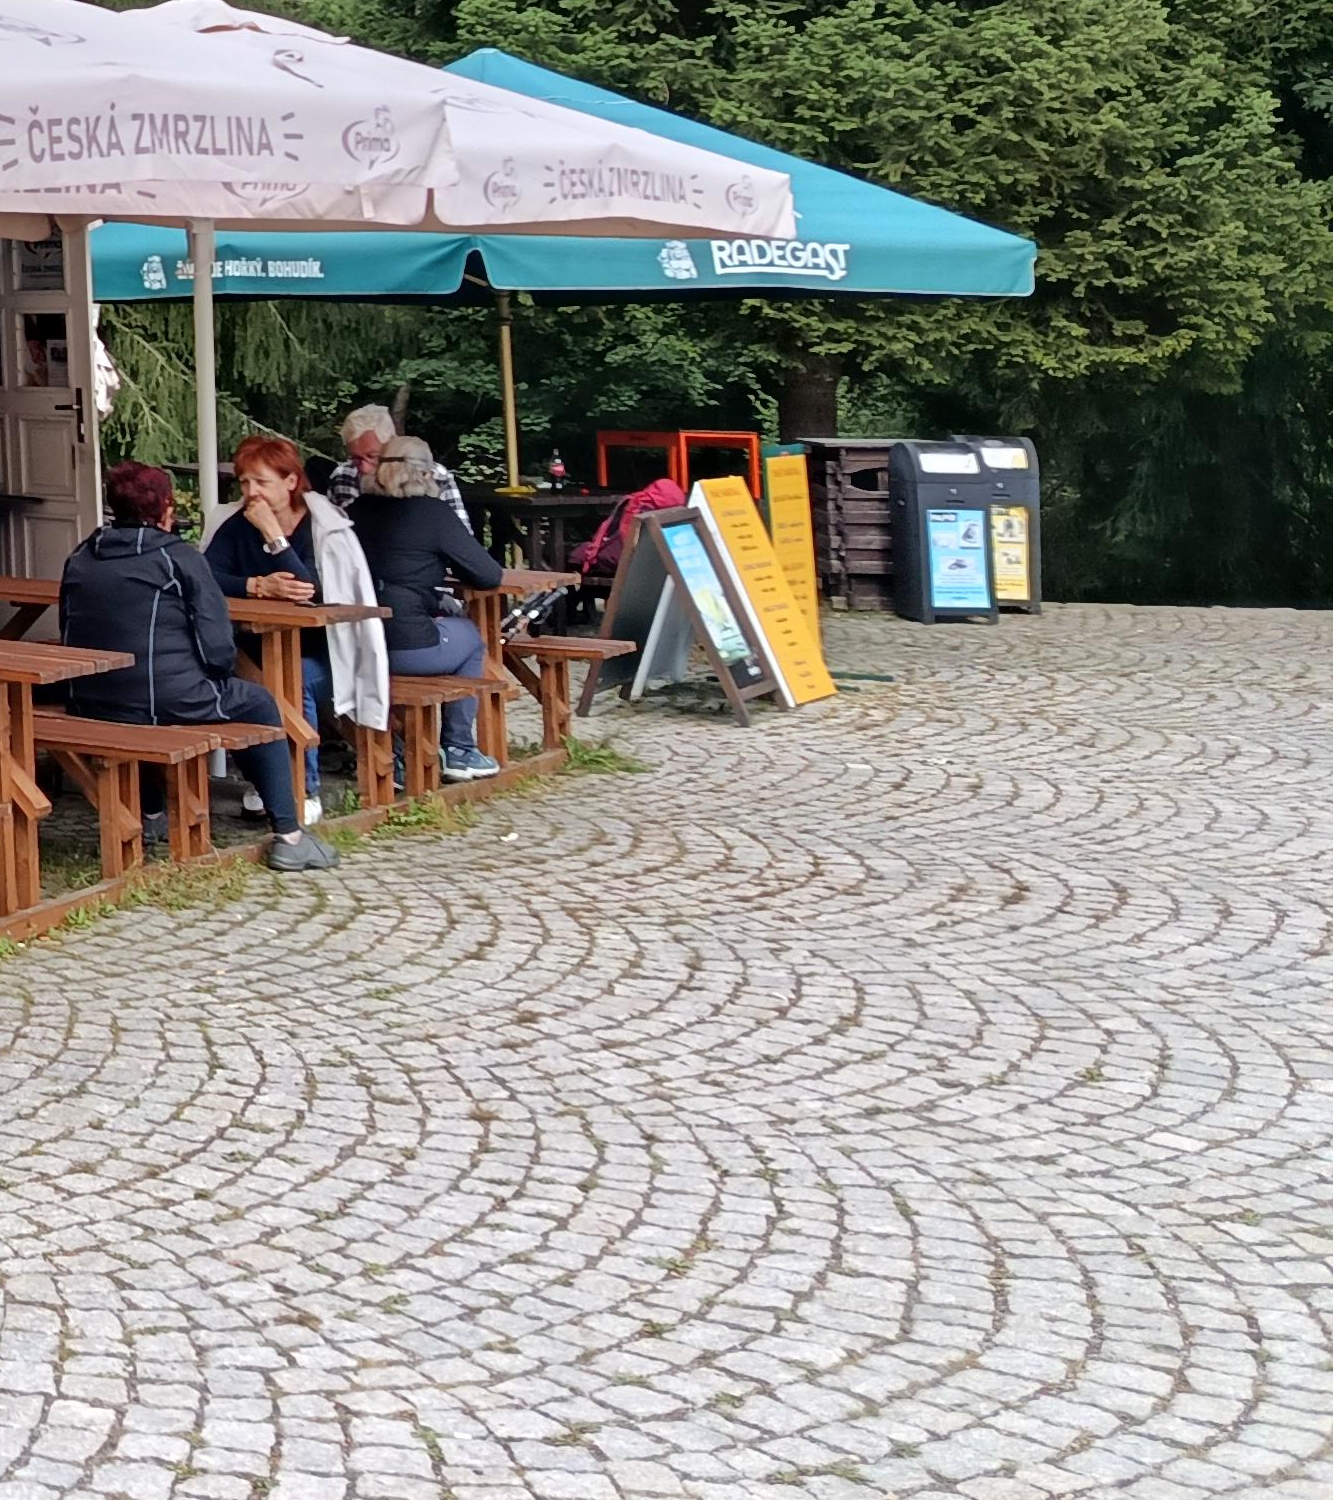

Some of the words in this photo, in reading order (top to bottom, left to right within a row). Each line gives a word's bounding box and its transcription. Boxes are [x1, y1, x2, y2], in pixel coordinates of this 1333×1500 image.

[27, 102, 126, 164] ČESKÁ
[131, 112, 275, 157] ZMRZLINA
[354, 130, 391, 152] Prima
[710, 240, 851, 281] RADEGAST
